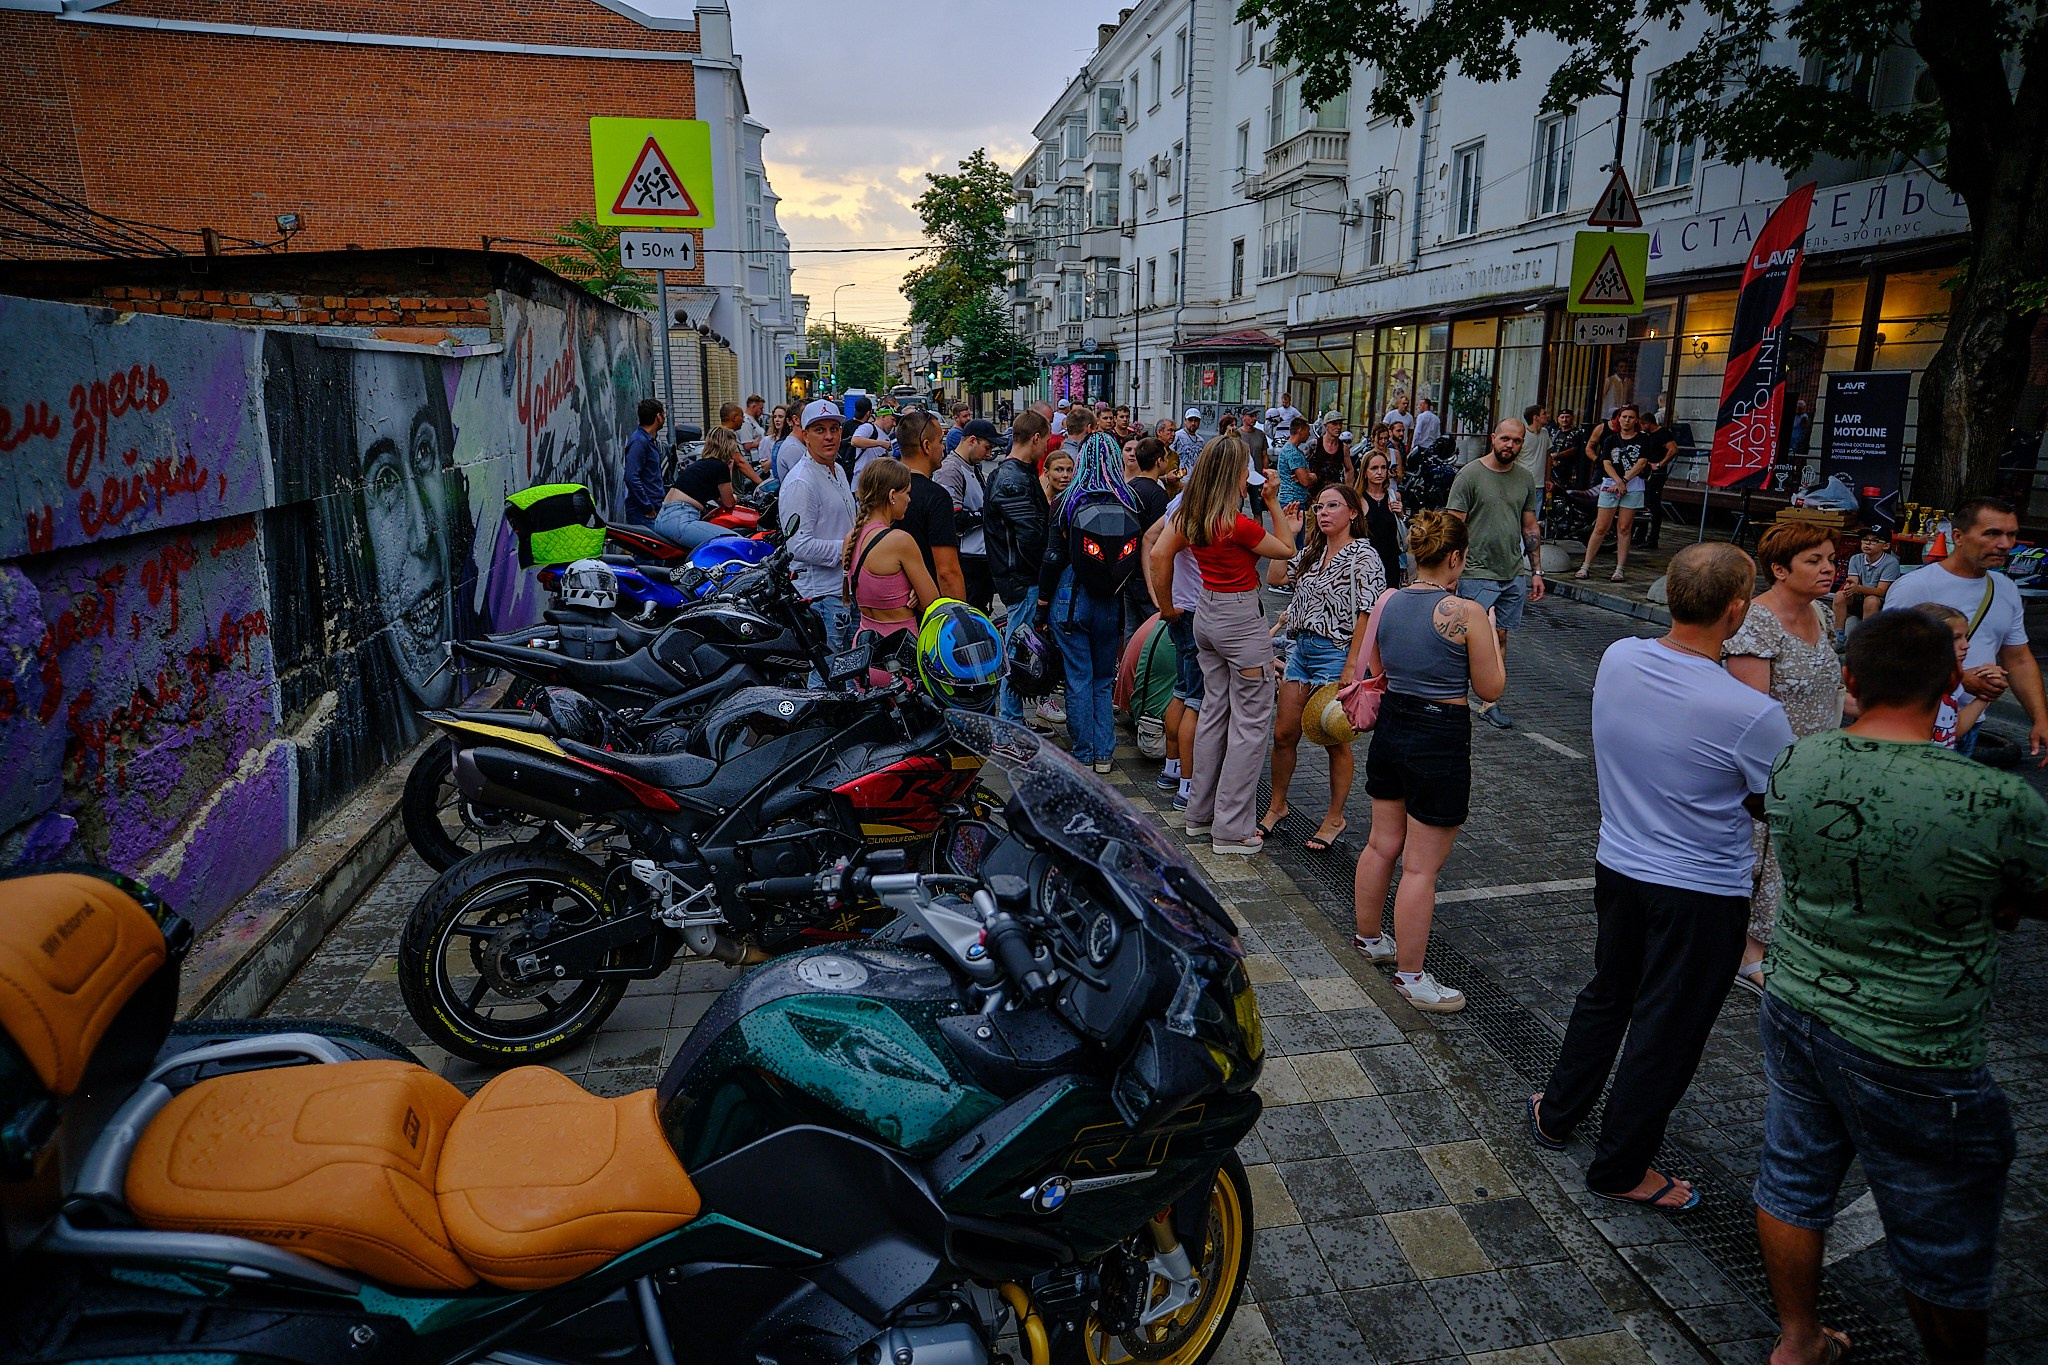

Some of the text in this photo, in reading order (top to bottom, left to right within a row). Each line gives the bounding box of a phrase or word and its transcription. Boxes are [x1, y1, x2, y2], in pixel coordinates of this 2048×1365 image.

[1681, 180, 1925, 252] СТАЕЛЬ
[1874, 220, 1922, 238] ПАРУС
[1753, 248, 1795, 270] LAVR
[1745, 326, 1777, 468] MOTOLINE
[1837, 382, 1865, 390] LAVR
[67, 363, 170, 490] здесь
[1833, 427, 1887, 438] MOTOLINE
[1834, 414, 1862, 424] LAVR
[1725, 401, 1752, 468] LAVR
[1132, 1281, 1144, 1319] brembo
